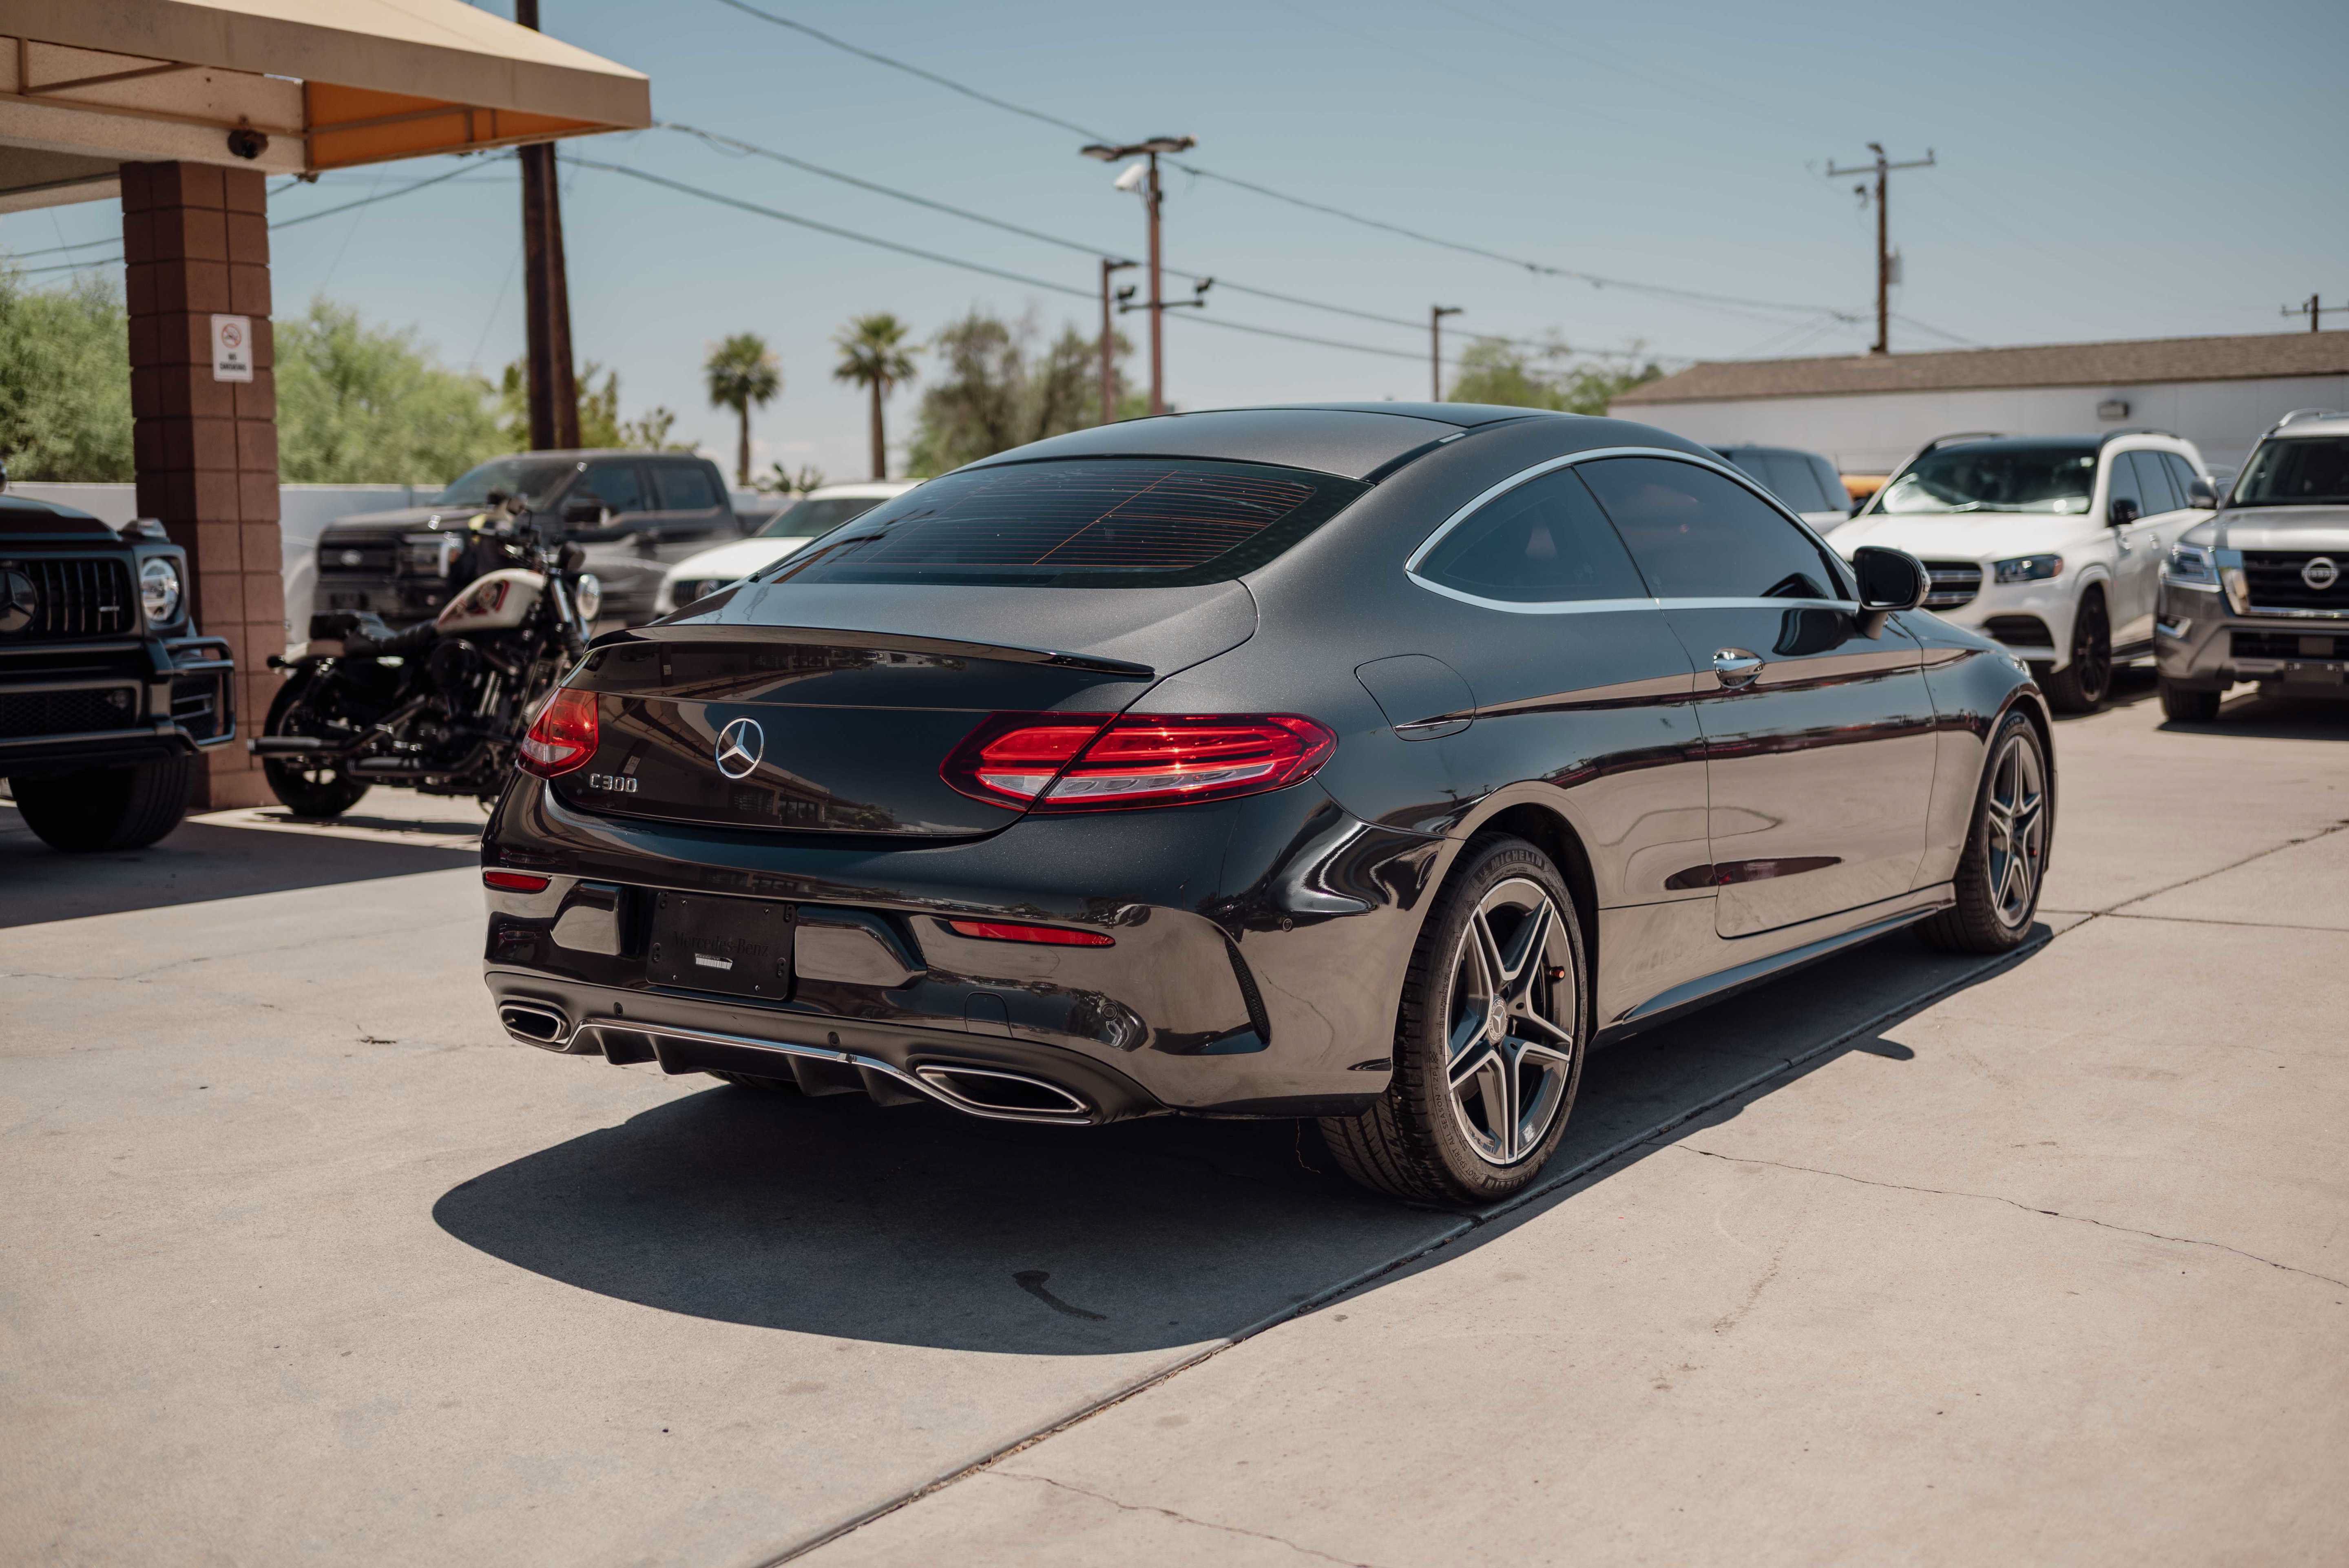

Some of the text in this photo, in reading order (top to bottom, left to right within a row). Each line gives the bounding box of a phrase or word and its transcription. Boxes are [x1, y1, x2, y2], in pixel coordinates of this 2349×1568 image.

[1491, 850, 1543, 870] MICHELIN
[674, 931, 769, 957] Mercedes-Benz
[1433, 1072, 1439, 1085] ZP
[1436, 1094, 1448, 1130] SEASON
[1446, 1134, 1455, 1145] ALL
[1453, 1148, 1469, 1169] SPORT
[1466, 1168, 1479, 1182] PILOT
